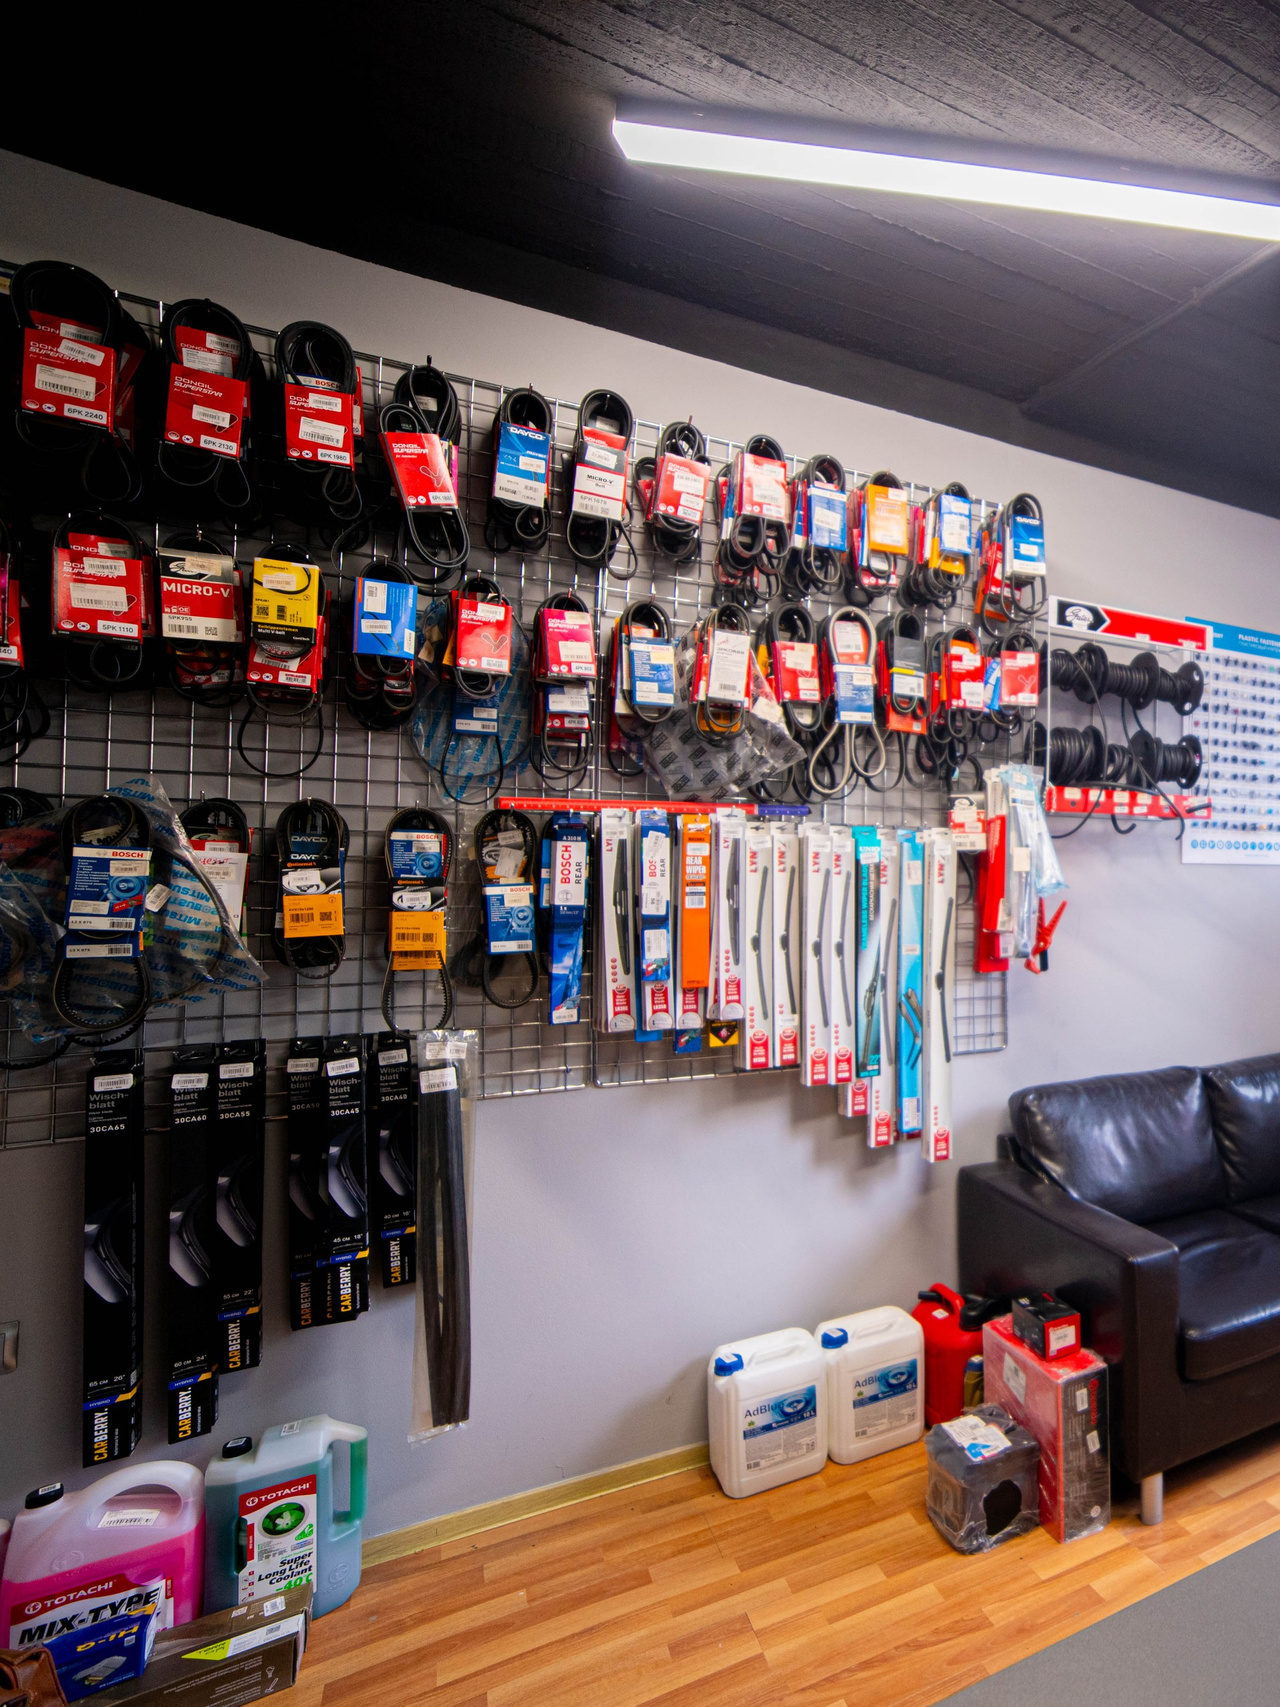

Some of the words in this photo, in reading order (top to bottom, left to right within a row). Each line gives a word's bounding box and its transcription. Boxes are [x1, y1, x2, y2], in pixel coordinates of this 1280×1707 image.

[173, 381, 223, 398] SUPERSTAR
[174, 376, 213, 390] DONGIL
[67, 407, 83, 416] 6PK
[84, 411, 104, 420] 2240
[509, 426, 544, 440] DAYCO
[203, 438, 217, 448] 6PK
[218, 442, 234, 451] 2130
[586, 474, 613, 484] MICRO-V
[162, 582, 230, 598] MICRO-V
[1238, 634, 1259, 643] PLASTIC
[291, 835, 328, 843] DAYCO
[560, 844, 572, 884] BOSCH
[685, 856, 702, 865] REAR
[574, 861, 582, 884] REAR
[685, 865, 706, 874] WIPER
[170, 883, 211, 903] MITSU
[379, 1066, 409, 1074] Wisch-
[218, 1082, 253, 1090] Wisch-
[329, 1078, 362, 1087] Wisch-
[329, 1086, 351, 1094] blatt
[89, 1093, 129, 1101] Wisch-
[381, 1094, 408, 1102] 30CA40
[89, 1101, 115, 1110] blatt
[292, 1102, 320, 1110] 30CA50
[330, 1107, 360, 1117] 30CA45
[174, 1114, 207, 1124] 30CA60
[219, 1111, 250, 1119] 30CA55
[89, 1124, 126, 1133] 30CA65
[389, 1238, 401, 1283] CARBERRY.
[339, 1263, 352, 1312] CARBERRY.
[228, 1319, 241, 1369] CARBERRY.
[178, 1387, 191, 1438] CARBERRY.
[94, 1408, 108, 1461] CARBERRY.
[260, 1483, 310, 1502] TOTACHI
[279, 1551, 314, 1568] Super
[257, 1567, 287, 1582] Long
[288, 1559, 310, 1573] Life
[269, 1565, 313, 1585] Coolant
[44, 1581, 113, 1608] TOTACHI
[18, 1586, 162, 1645] MIX-TYPE
